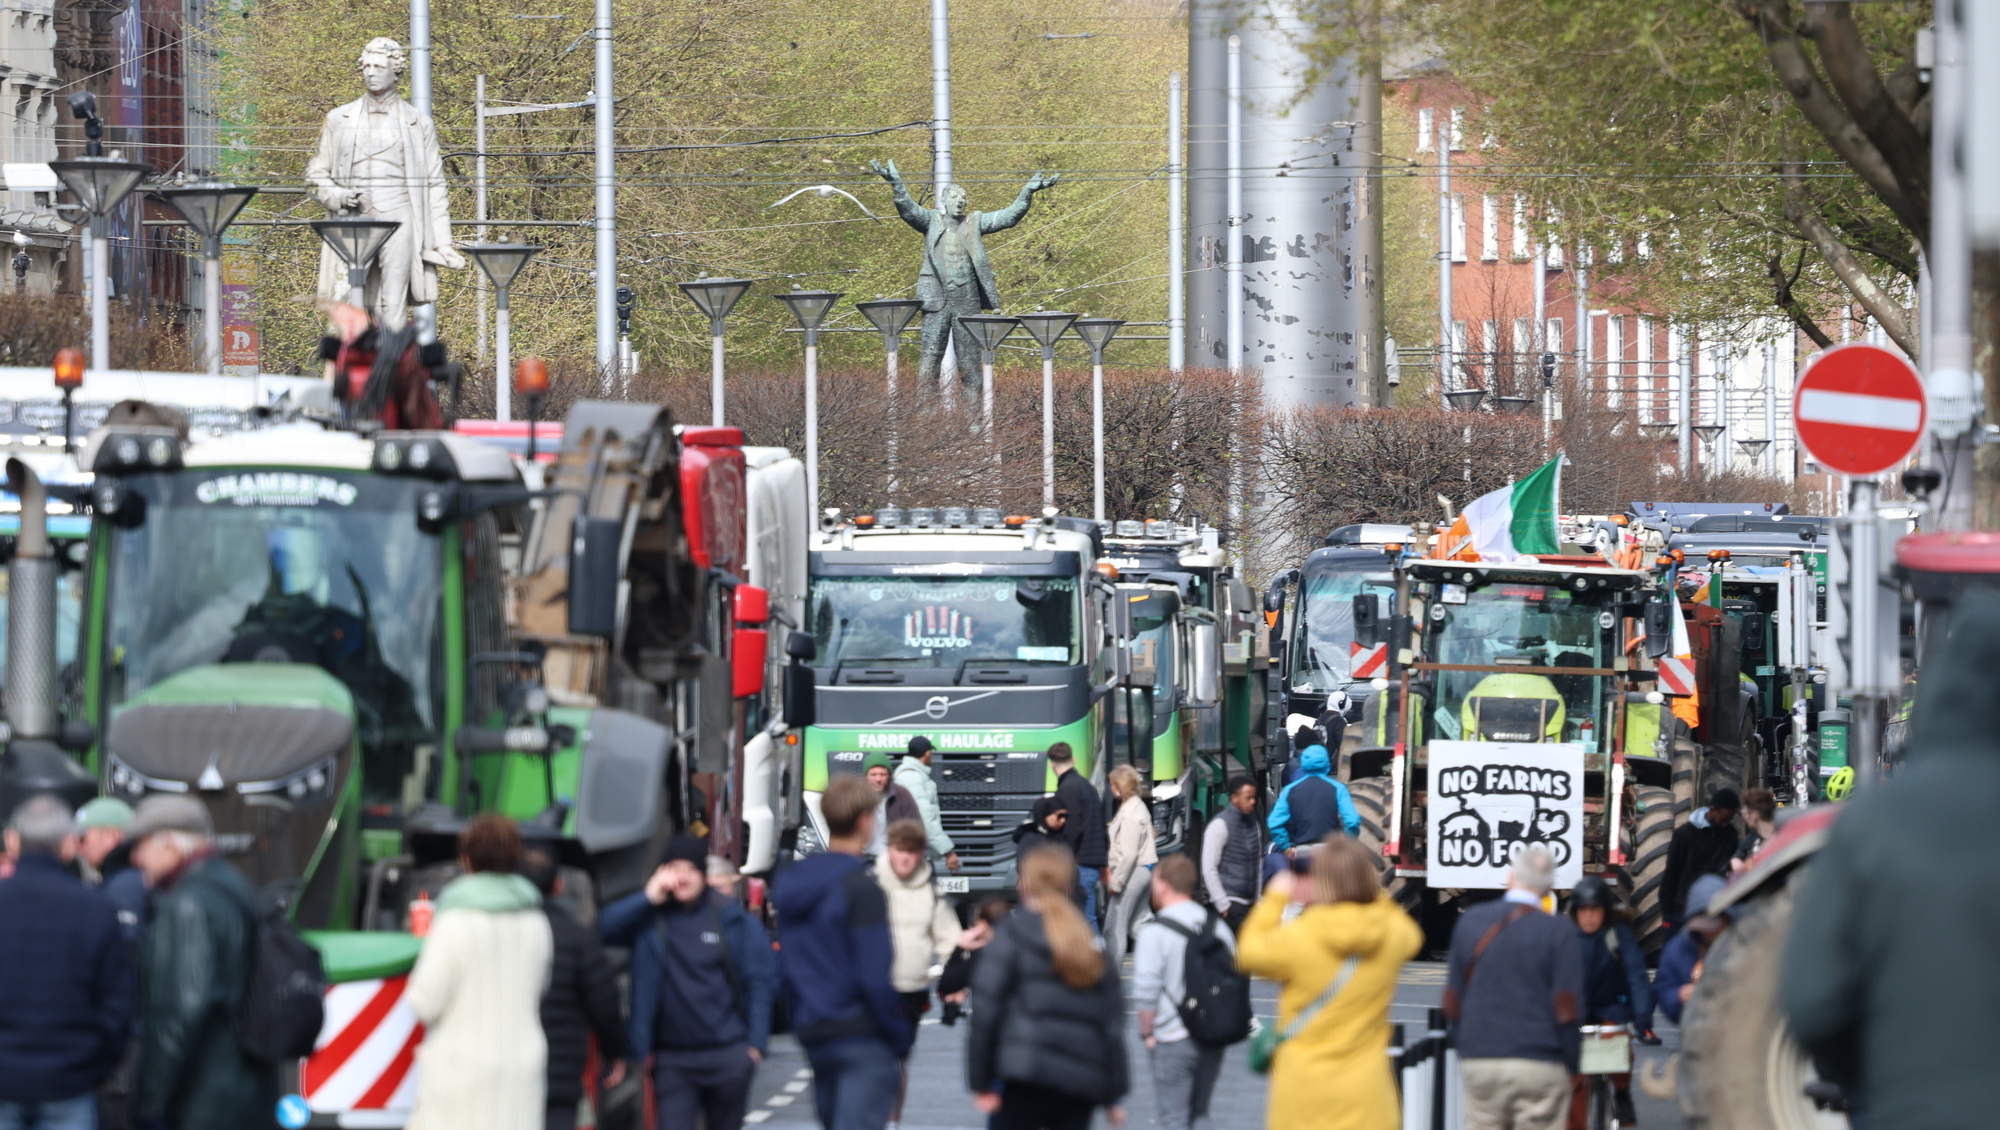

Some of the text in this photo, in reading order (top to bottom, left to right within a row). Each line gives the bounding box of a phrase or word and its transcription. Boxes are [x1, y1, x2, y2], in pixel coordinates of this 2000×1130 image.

[910, 637, 968, 648] VOLVO
[858, 733, 1014, 748] FARREY HAULAGE
[834, 752, 864, 762] 460
[1442, 768, 1568, 797] NO FARMS
[1442, 838, 1484, 864] NO
